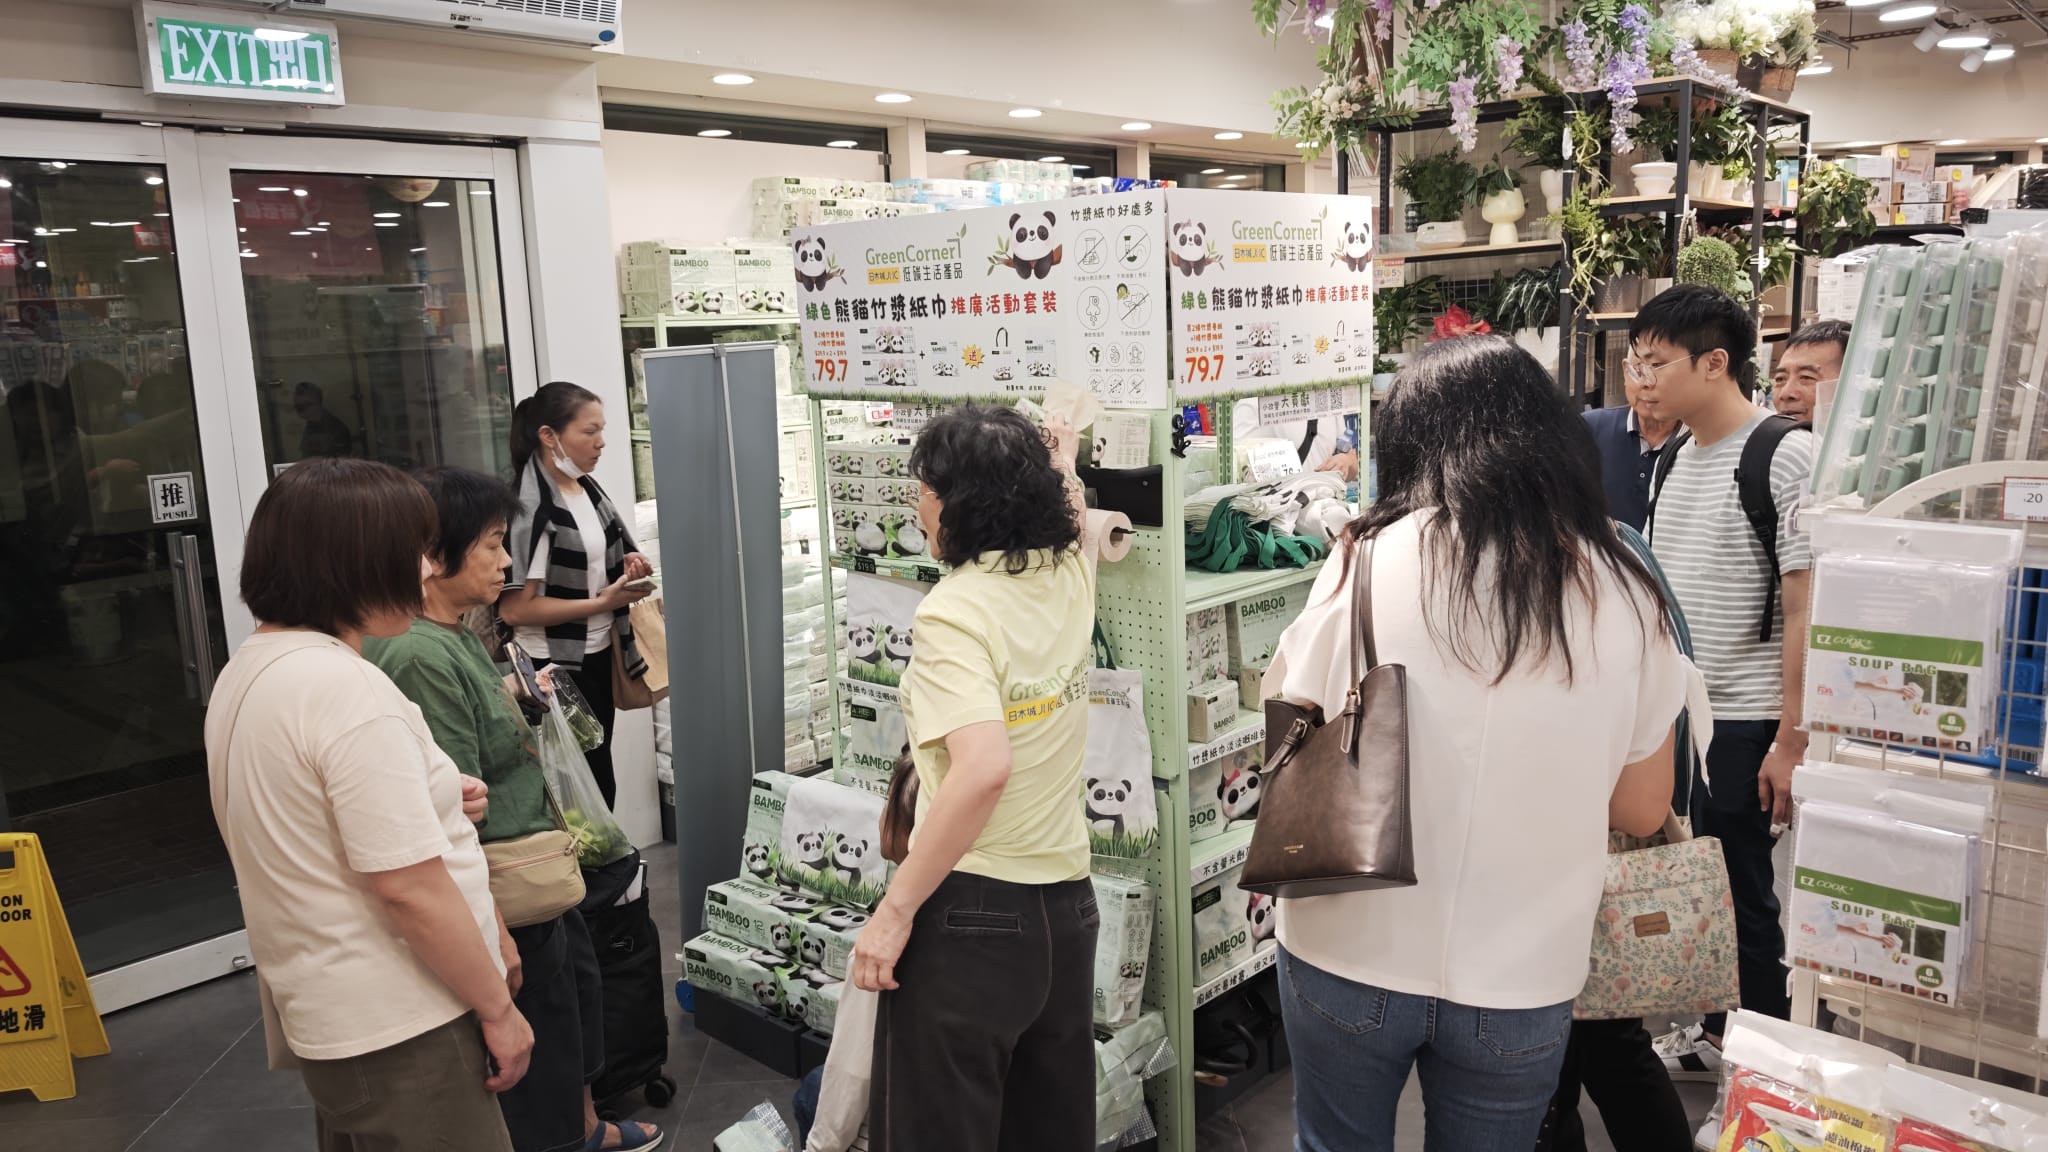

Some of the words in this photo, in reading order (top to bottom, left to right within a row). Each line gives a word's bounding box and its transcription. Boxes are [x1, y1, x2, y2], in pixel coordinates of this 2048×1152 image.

[163, 24, 267, 86] EXIT
[269, 39, 327, 90] 出口
[786, 186, 816, 196] BAMBOO
[823, 208, 853, 217] BAMBOO
[1071, 200, 1153, 221] 竹漿紙巾好處多
[1232, 219, 1319, 241] GreenCorner
[674, 259, 709, 267] BAMBOO
[738, 259, 771, 267] BAMBOO
[866, 243, 957, 266] GreenCorner
[1270, 244, 1323, 262] 低碳生活產品
[903, 263, 963, 283] 低碳生活產品
[160, 483, 185, 507] 推
[162, 510, 188, 520] PUSH
[1241, 595, 1286, 618] BAMBOO
[1816, 634, 1832, 645] EZ
[1848, 656, 1894, 670] SOUP
[1902, 663, 1937, 676] BAG
[1213, 713, 1236, 730] BAMBOO
[724, 881, 770, 900] BAMBOO
[1799, 875, 1815, 888] EZ
[708, 904, 750, 929] BAMBOO
[753, 919, 764, 931] 12
[1831, 900, 1874, 918] SOUP
[1881, 913, 1917, 929] BAG
[700, 933, 749, 954] BAMBOO
[1200, 930, 1247, 968] BAMBOO
[686, 961, 733, 987] BAMBOO
